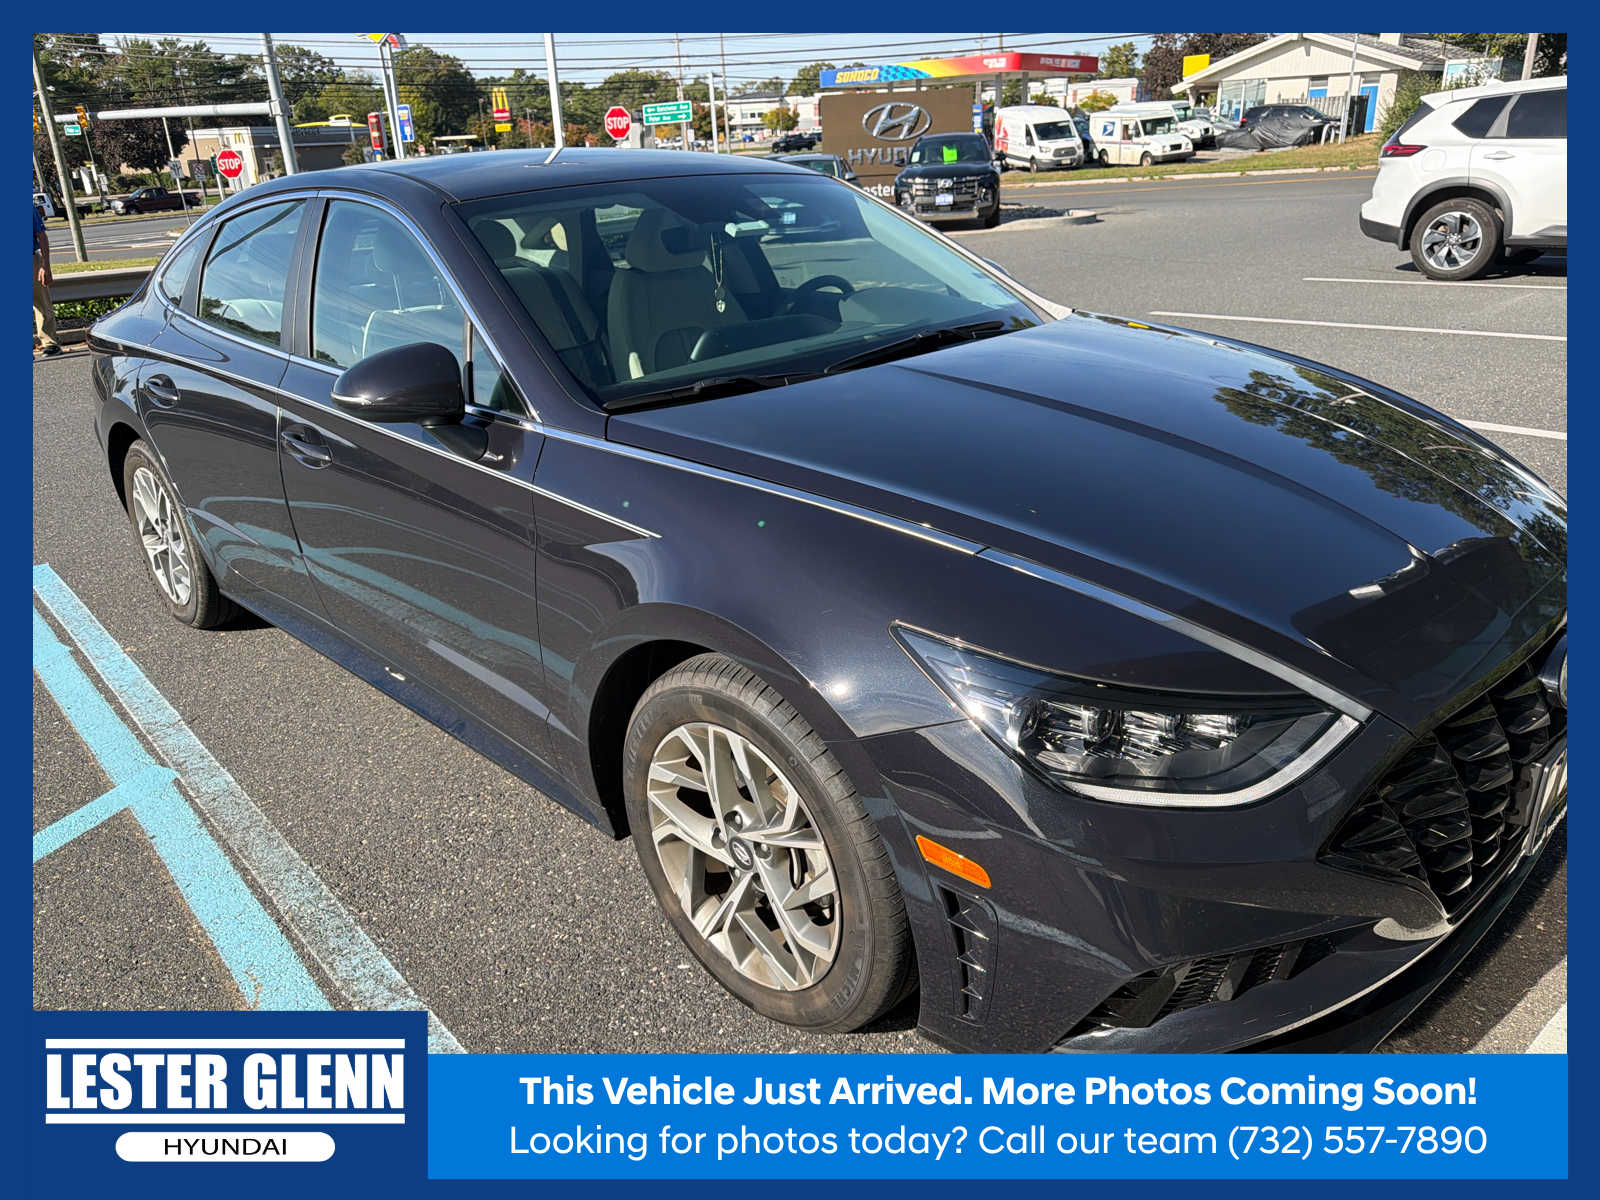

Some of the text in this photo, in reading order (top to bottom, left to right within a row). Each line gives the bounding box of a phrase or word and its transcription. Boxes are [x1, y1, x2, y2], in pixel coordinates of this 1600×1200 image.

[835, 68, 880, 83] SUNOCO
[607, 116, 629, 130] STOP
[218, 158, 241, 170] STOP
